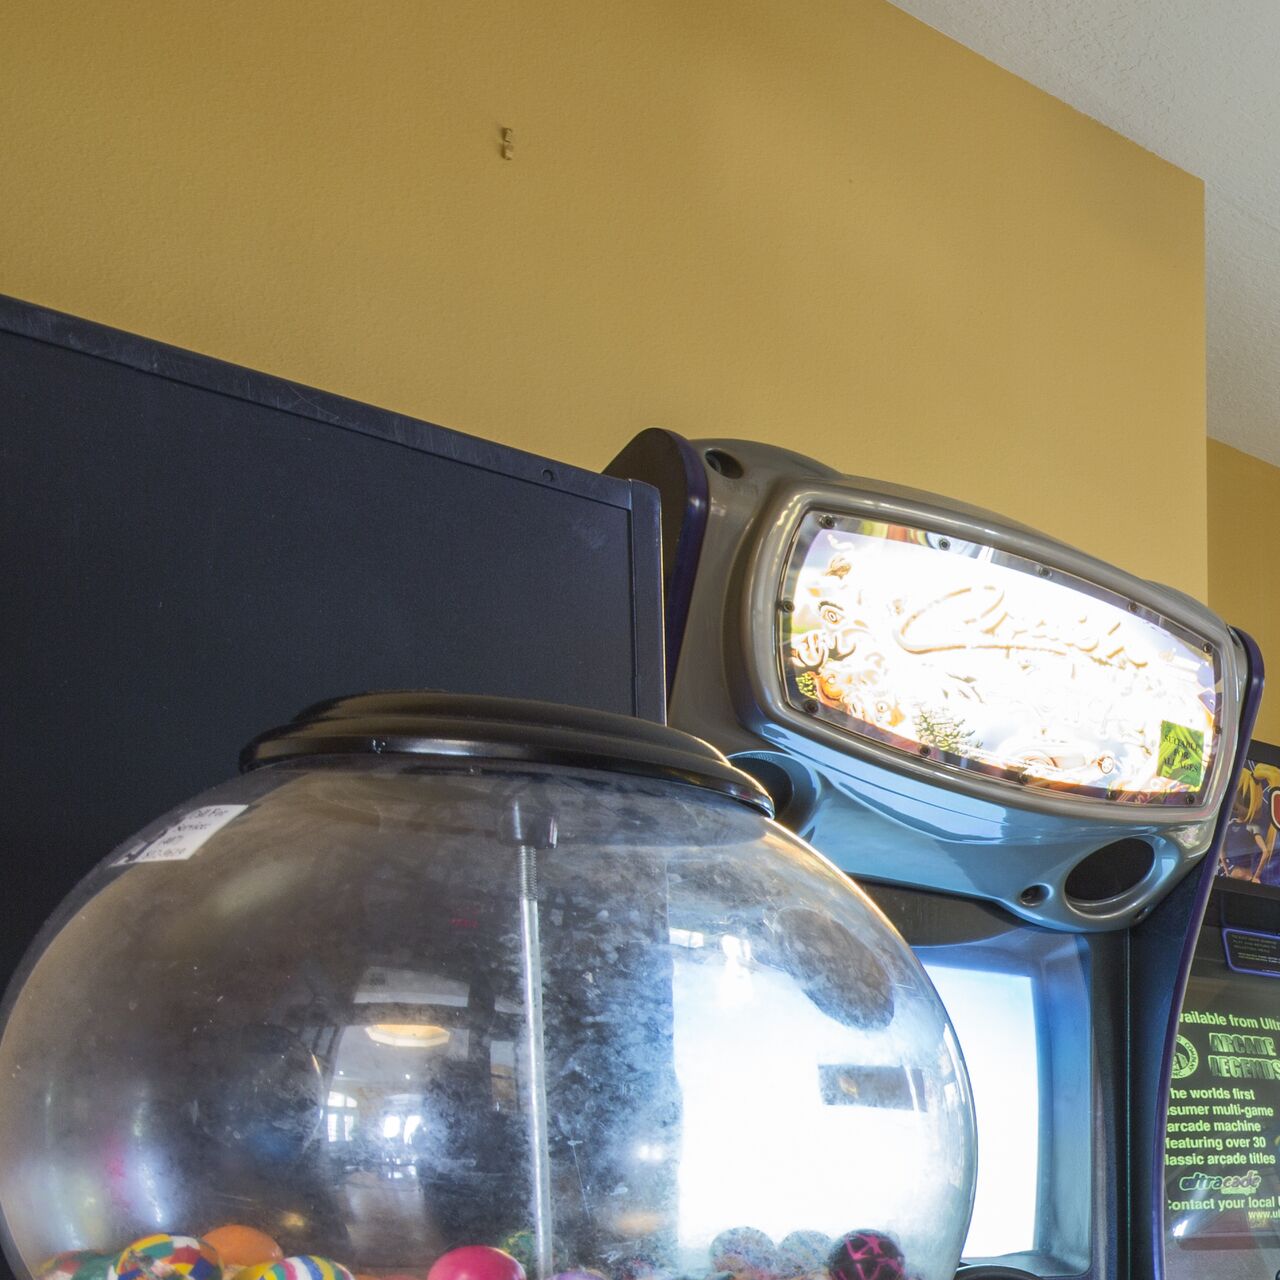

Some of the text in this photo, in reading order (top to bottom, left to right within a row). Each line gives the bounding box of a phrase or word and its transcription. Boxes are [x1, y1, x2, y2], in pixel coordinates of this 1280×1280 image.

[1173, 748, 1189, 761] FOR
[1180, 762, 1199, 773] AGES
[1178, 1010, 1228, 1027] vailable
[1229, 1014, 1258, 1029] from
[1208, 1032, 1277, 1057] ARCADE
[1170, 1087, 1256, 1101] he worlds first
[1167, 1103, 1274, 1119] sumer multi-game
[1167, 1120, 1262, 1133] arcade machine
[1165, 1136, 1267, 1151] featuring over 30
[1165, 1151, 1276, 1166] lassic arcade titles
[1218, 1198, 1246, 1213] your
[1248, 1195, 1276, 1209] local
